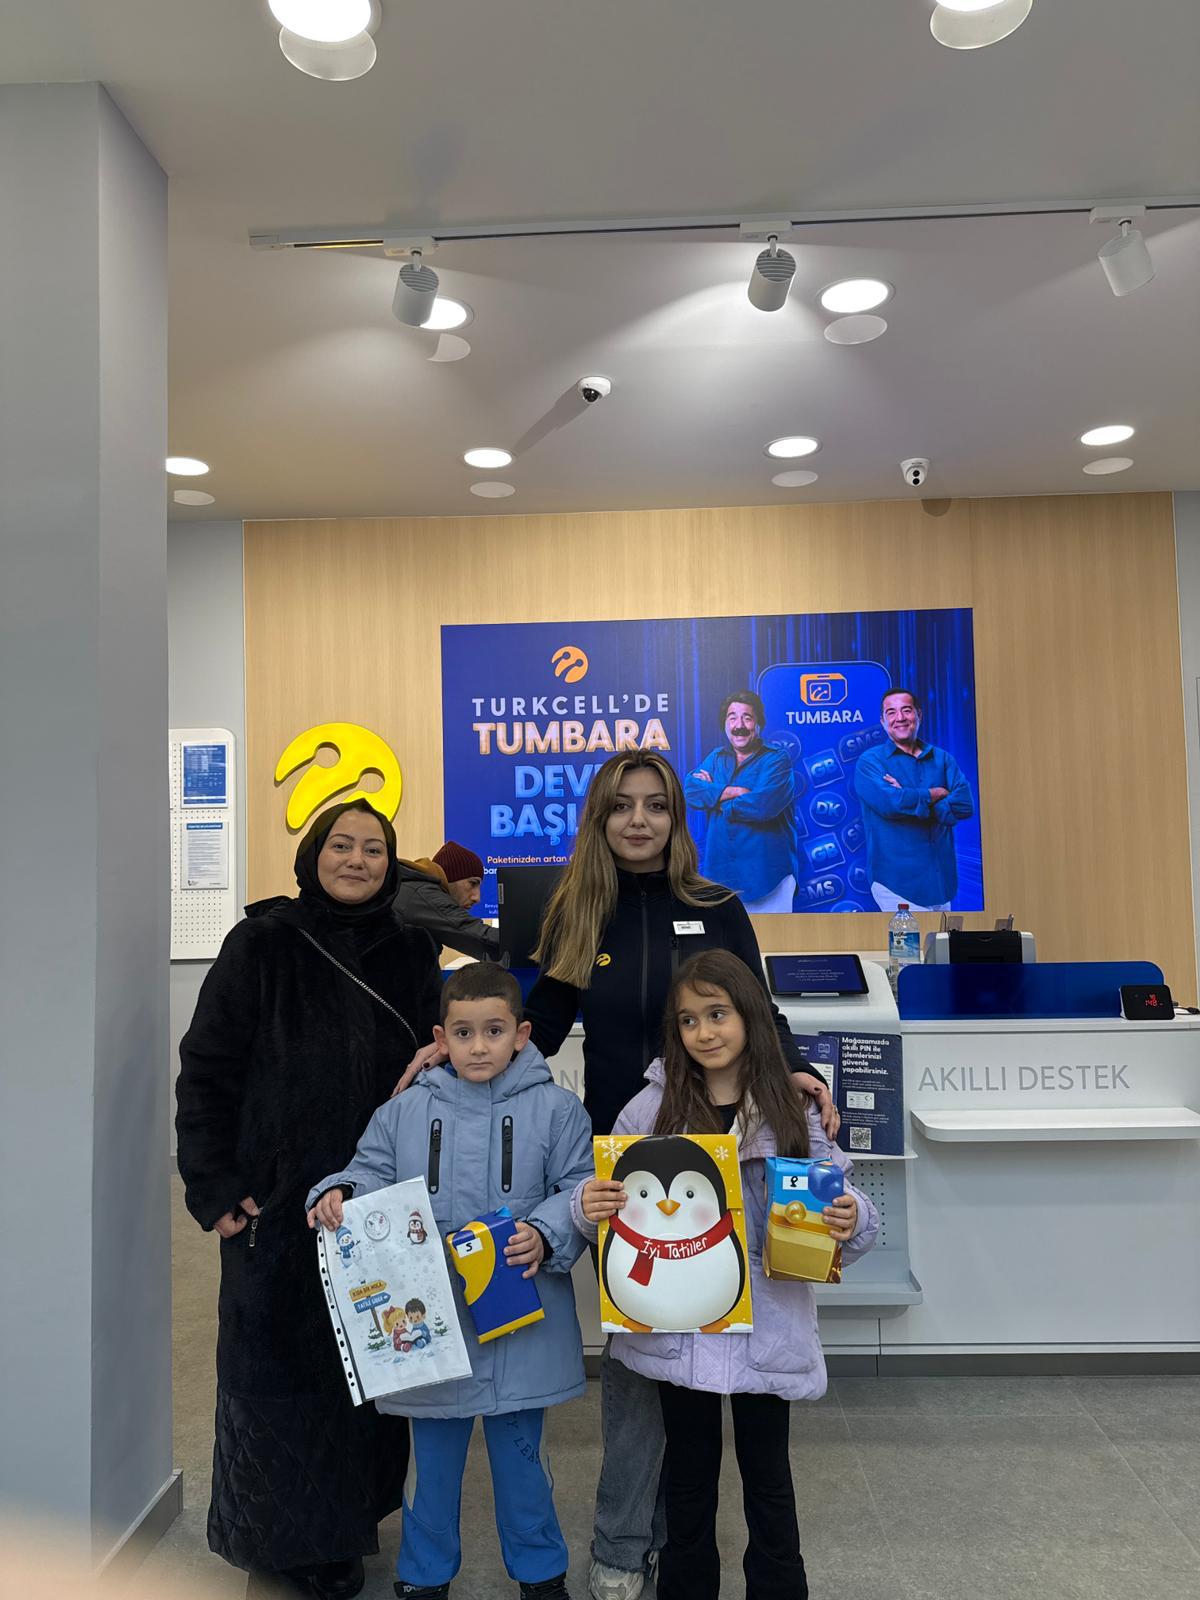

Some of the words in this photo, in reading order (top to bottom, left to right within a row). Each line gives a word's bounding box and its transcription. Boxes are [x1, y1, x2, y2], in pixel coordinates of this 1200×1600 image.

[472, 693, 669, 716] TURKCELL'DE
[785, 709, 864, 725] TUMBARA
[472, 718, 671, 755] TUMBARA
[810, 758, 838, 778] GB
[514, 764, 603, 798] DEV
[815, 801, 841, 817] DK
[487, 856, 541, 864] Paketinizden
[543, 855, 567, 863] artan
[811, 842, 839, 862] GB
[842, 1037, 889, 1045] Mağazamızda
[842, 1051, 881, 1059] işlemlerinizi
[842, 1059, 869, 1067] güvenle
[918, 1066, 1007, 1091] AKILLI
[1018, 1065, 1130, 1091] DESTEK
[664, 1237, 708, 1259] Tatiller
